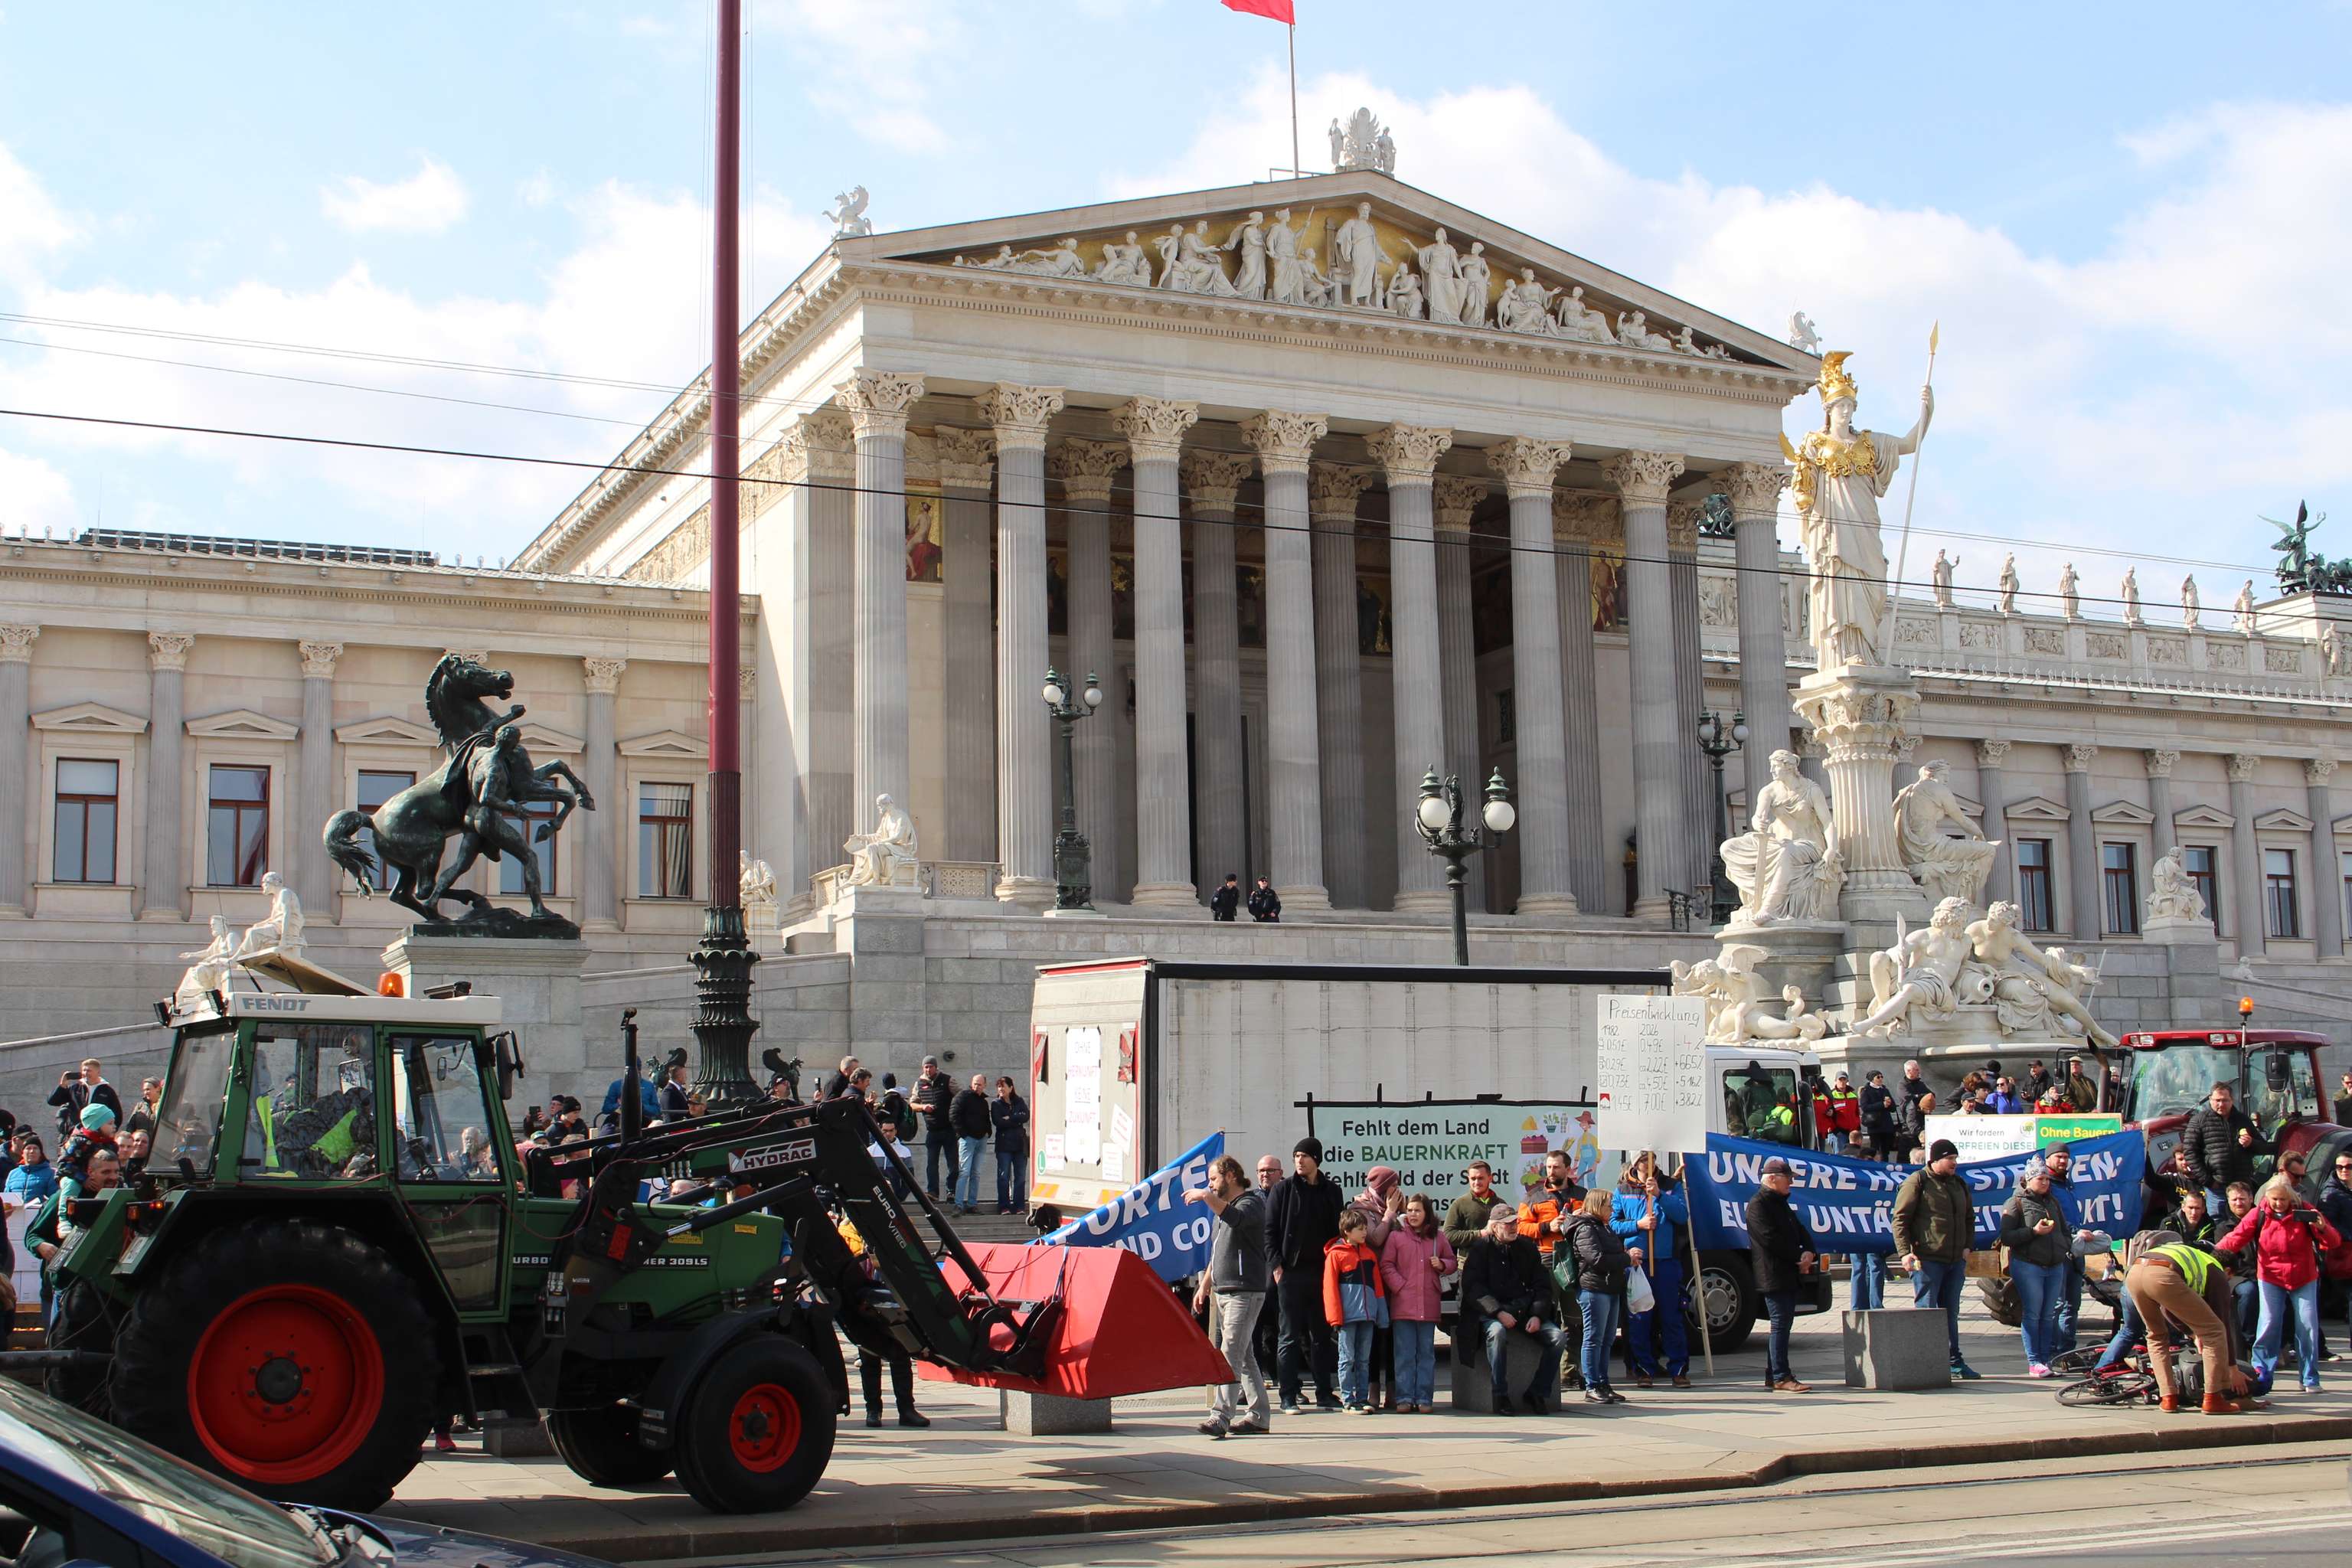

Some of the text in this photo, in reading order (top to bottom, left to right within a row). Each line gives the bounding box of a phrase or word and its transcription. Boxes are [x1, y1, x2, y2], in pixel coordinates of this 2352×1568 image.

[242, 998, 311, 1011] FENDT
[1609, 998, 1700, 1027] Preisentwicklung
[1602, 1024, 1659, 1036] 1982 2026
[1343, 1119, 1489, 1136] Fehlt dem Land
[2040, 1126, 2071, 1138] Ohne
[743, 1148, 812, 1169] HYDRAC
[1325, 1143, 1508, 1162] die BAUERNKRAFT
[1325, 1169, 1509, 1187] fehlt ld der Sdt
[873, 1185, 896, 1219] EURO
